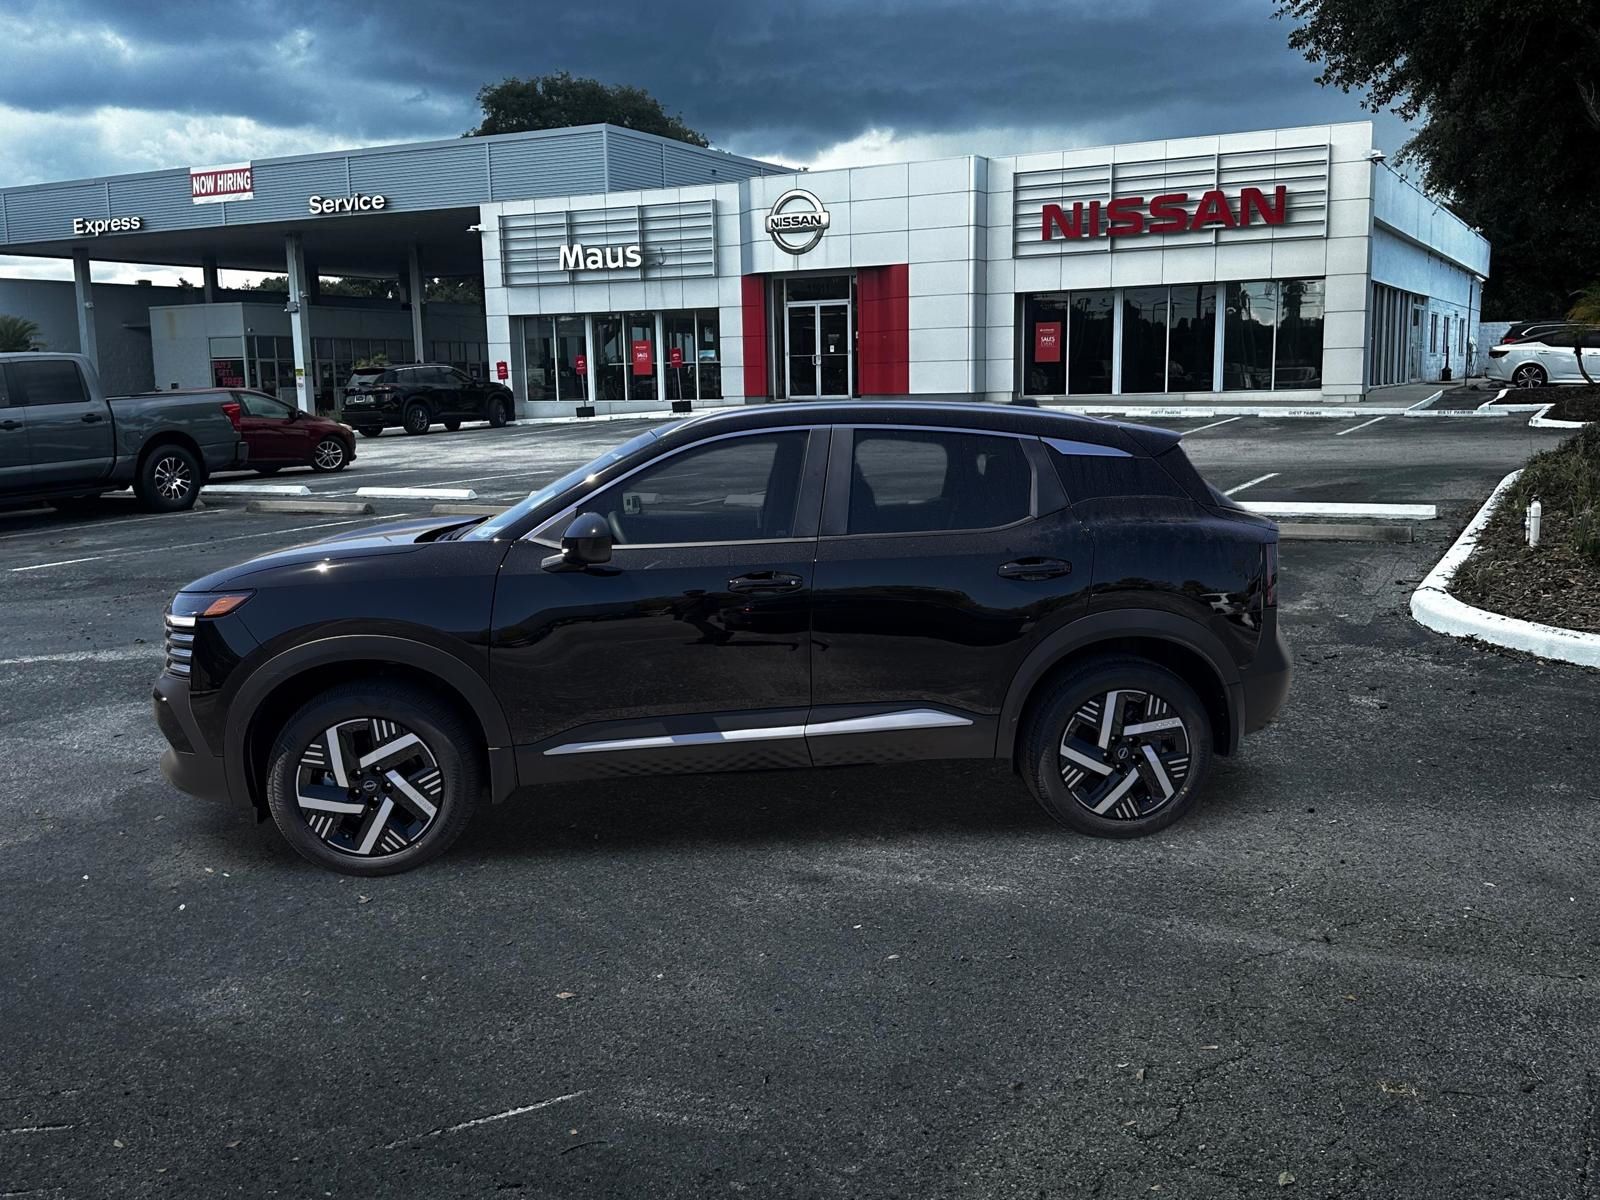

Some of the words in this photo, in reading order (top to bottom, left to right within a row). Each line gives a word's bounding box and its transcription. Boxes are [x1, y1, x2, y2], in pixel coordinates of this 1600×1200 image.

[192, 175, 215, 195] NOW
[217, 171, 251, 192] HIRING
[309, 193, 385, 215] Service
[1042, 185, 1287, 241] NISSAN
[73, 216, 141, 236] Express
[770, 215, 821, 228] NISSAN
[560, 243, 642, 271] Maus
[223, 376, 244, 386] FREE
